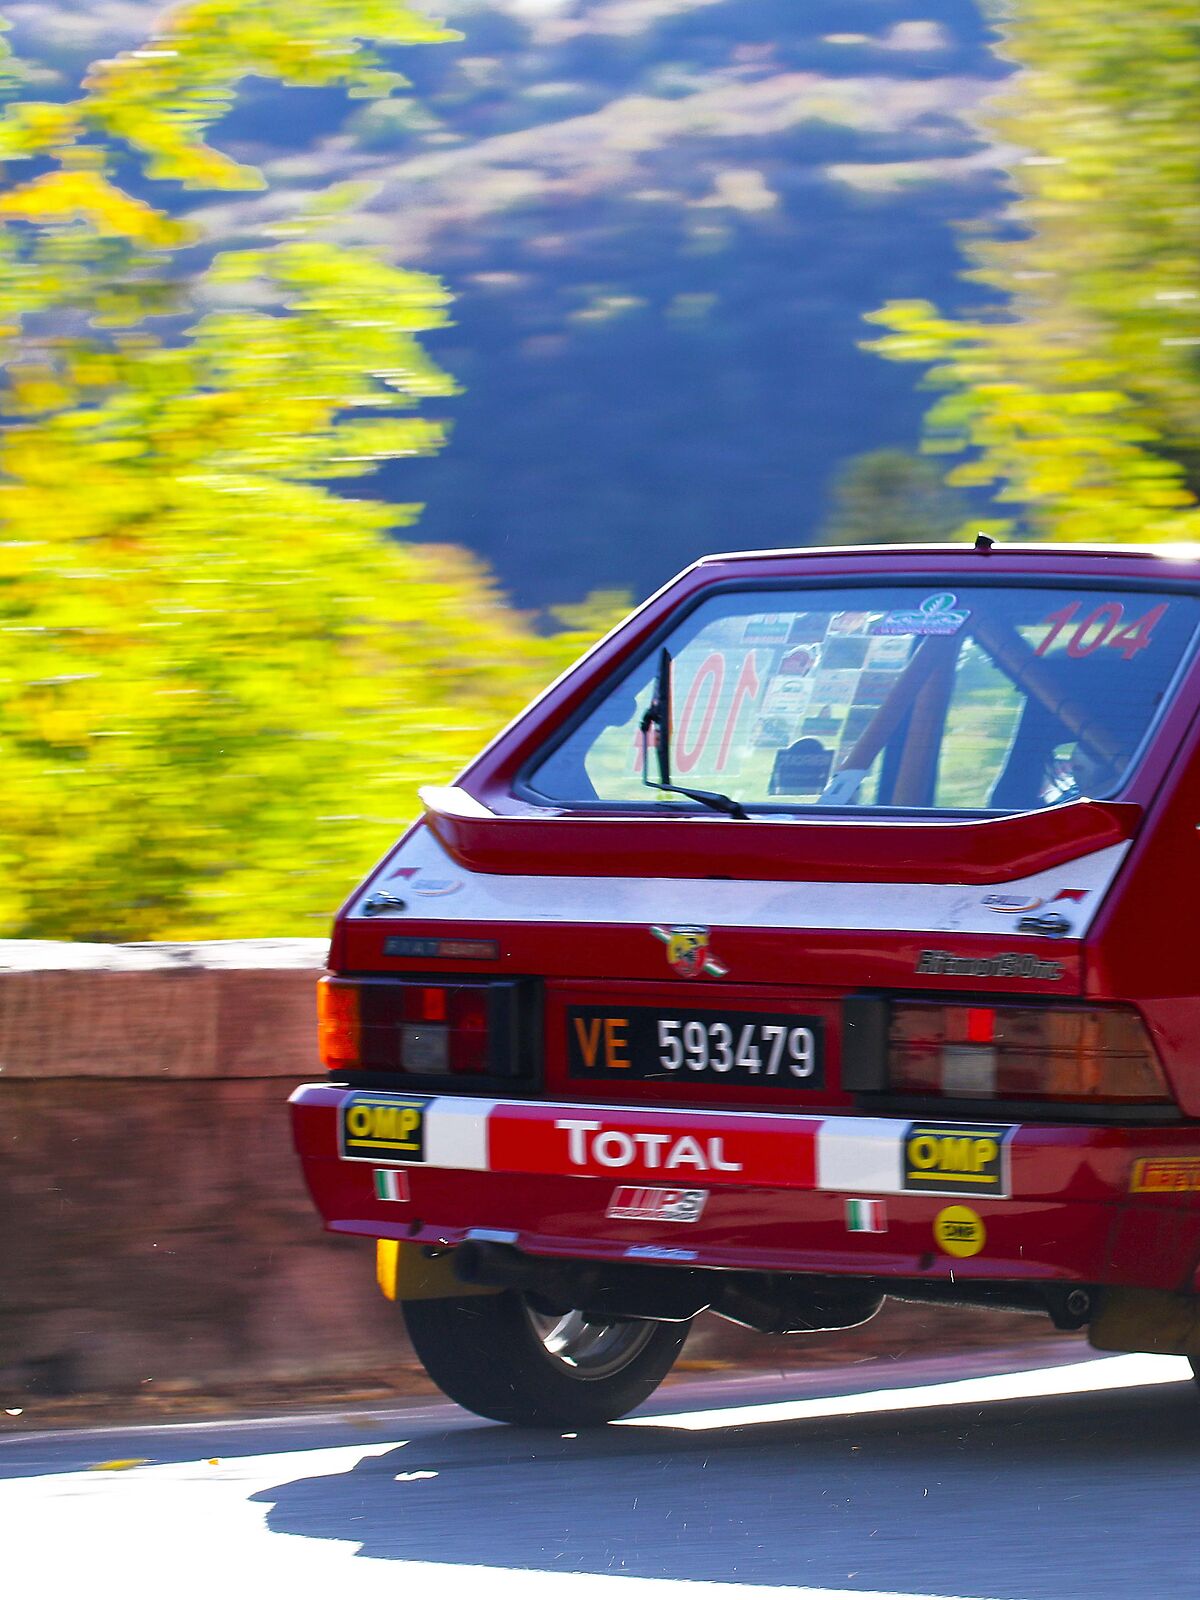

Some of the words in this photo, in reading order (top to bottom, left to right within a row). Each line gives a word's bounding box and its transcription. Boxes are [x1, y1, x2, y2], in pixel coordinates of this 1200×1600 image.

[1034, 601, 1170, 661] 104
[574, 1017, 632, 1069] VE
[657, 1019, 815, 1077] 593479
[346, 1105, 419, 1140] OMP
[907, 1135, 999, 1173] OMP
